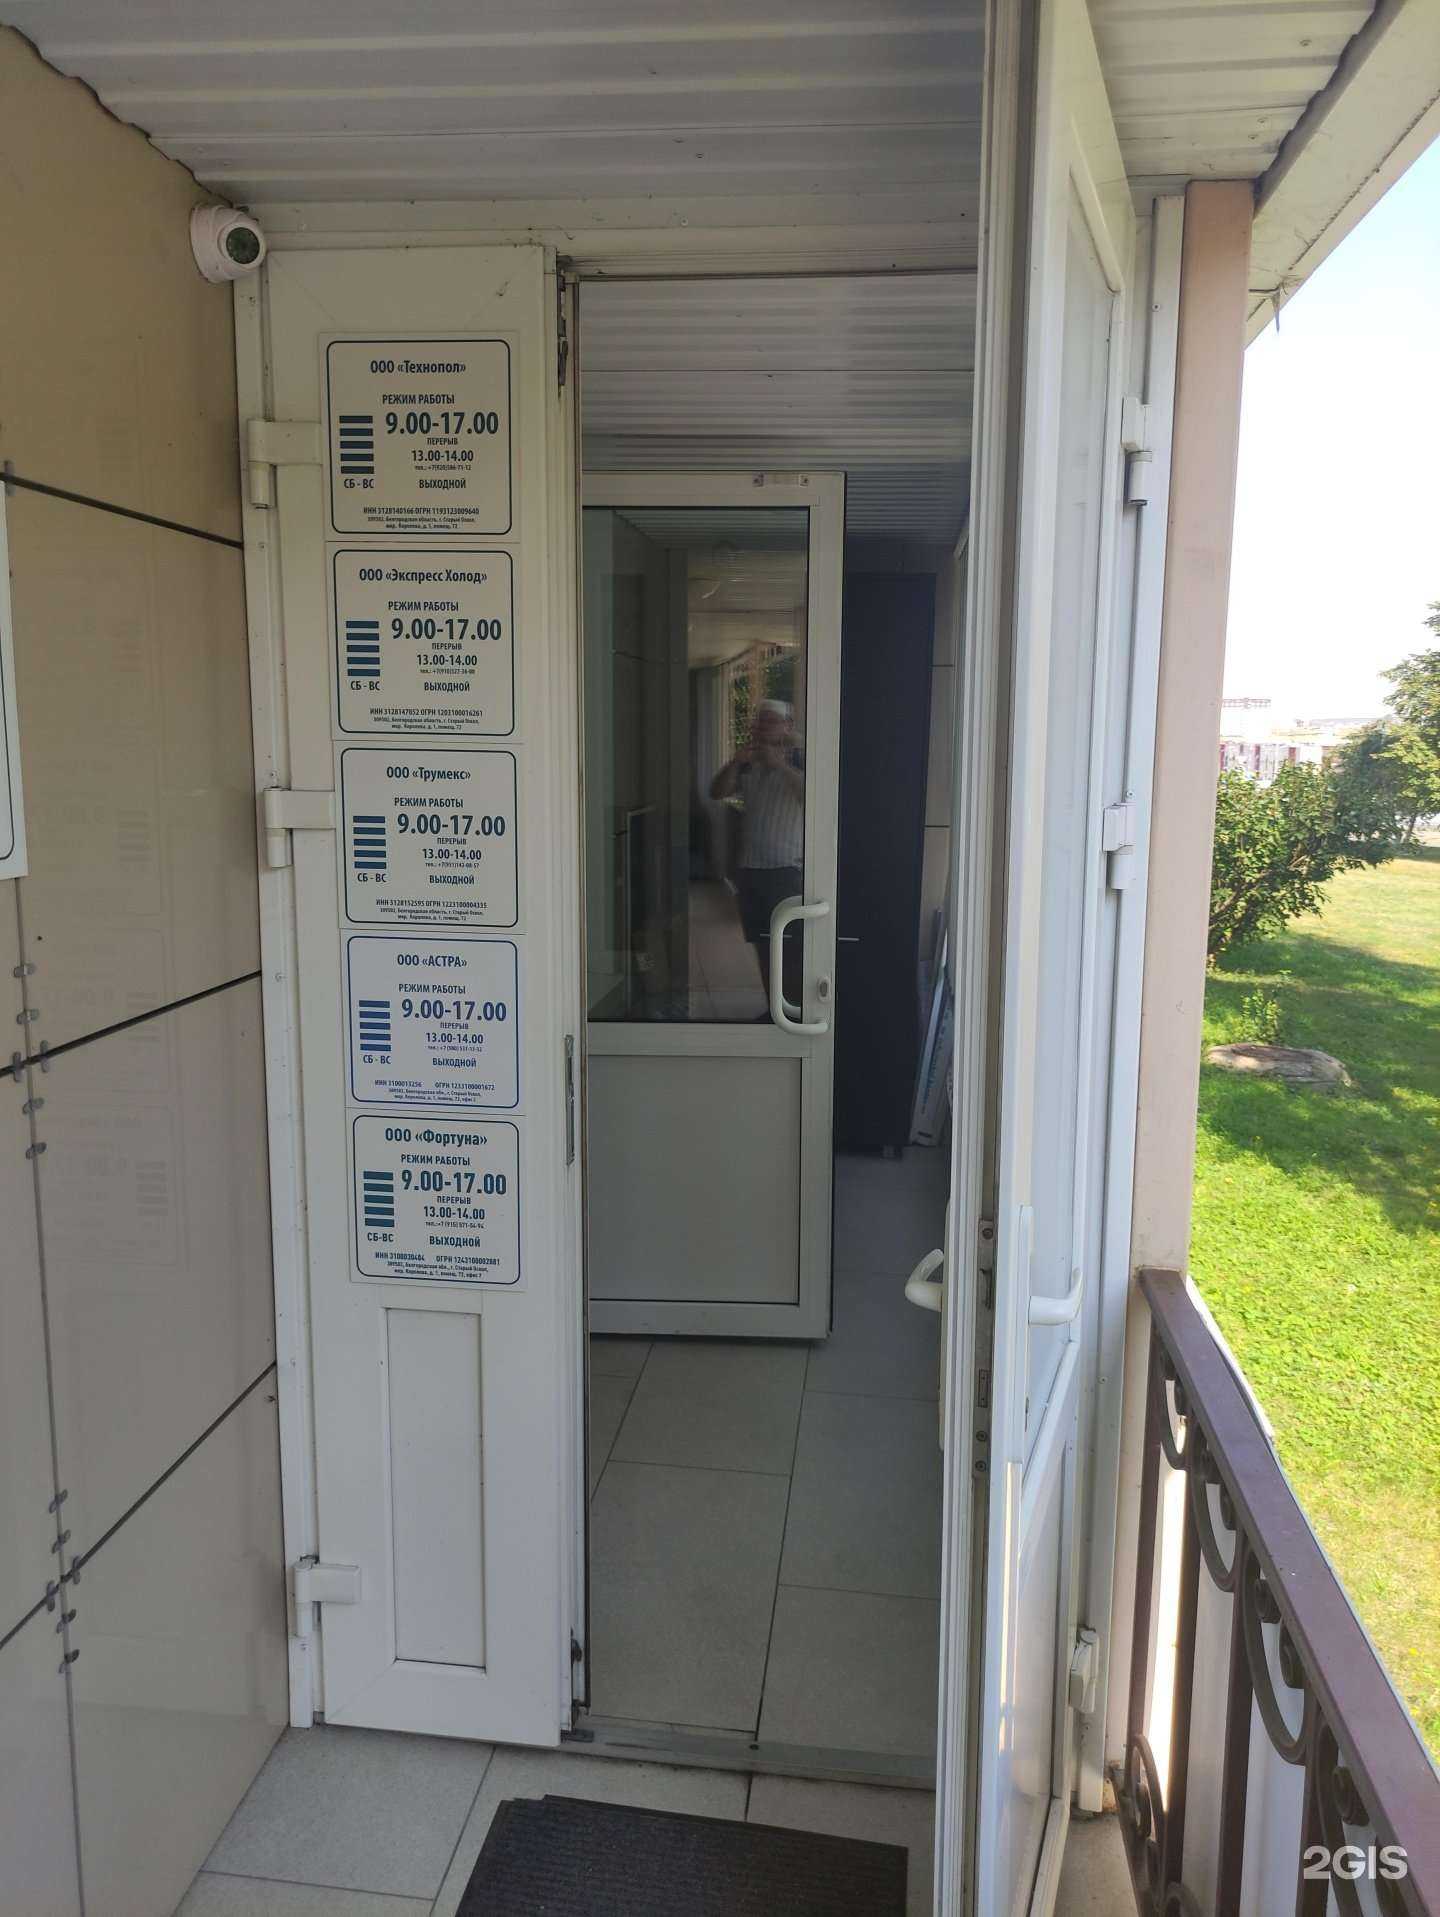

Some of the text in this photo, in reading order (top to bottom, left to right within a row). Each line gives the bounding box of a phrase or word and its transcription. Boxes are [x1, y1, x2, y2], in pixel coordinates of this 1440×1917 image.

[370, 360, 466, 374] ООО «Технопол»
[382, 394, 455, 404] РЕЖИМ РАБОТЫ
[385, 411, 498, 434] 9.00-17.00
[412, 450, 473, 462] 13.00-14.00
[344, 479, 355, 489] СБ
[363, 479, 374, 489] ВС
[419, 478, 466, 490] ВЫХОДНОЙ
[359, 568, 487, 584] ООО «Экспресс Холод»
[388, 601, 459, 611] РЕЖИМ РАБОТЫ
[391, 618, 501, 640] 9.00-17.00
[417, 654, 478, 666] 13.00-14.00
[350, 681, 362, 691] СБ
[369, 681, 380, 691] ВС
[424, 681, 470, 693] ВЫХОДНОЙ
[386, 766, 471, 782] ООО «Трумекс»
[394, 797, 464, 808] РЕЖИМ РАБОТЫ
[397, 813, 506, 836] 9.00-17.00
[437, 837, 467, 845] ПЕРЕРЫВ
[422, 848, 482, 860] 13.00-14.00
[357, 873, 369, 882] СБ
[375, 873, 387, 883] ВС
[429, 874, 475, 885] ВЫХОДНОЙ
[397, 954, 468, 968] ООО «АСТРА»
[398, 983, 466, 994] РЕЖИМ РАБОТЫ
[401, 999, 507, 1022] 9.00-17.00
[440, 1022, 469, 1030] ПЕРЕРЫВ
[426, 1032, 484, 1044] 13.00-14.00
[363, 1054, 374, 1064] СБ
[380, 1055, 391, 1064] ВС
[432, 1057, 477, 1068] ВЫХОДНОЙ
[385, 1128, 488, 1147] ООО «Фортуна»
[401, 1154, 471, 1166] РЕЖИМ РАБОТЫ
[401, 1169, 507, 1195] 9.00-17.00
[437, 1195, 472, 1204] ПЕРЕРЫВ
[424, 1206, 485, 1220] 13.00-14.00
[429, 1235, 481, 1248] ВЫХОДНОЙ
